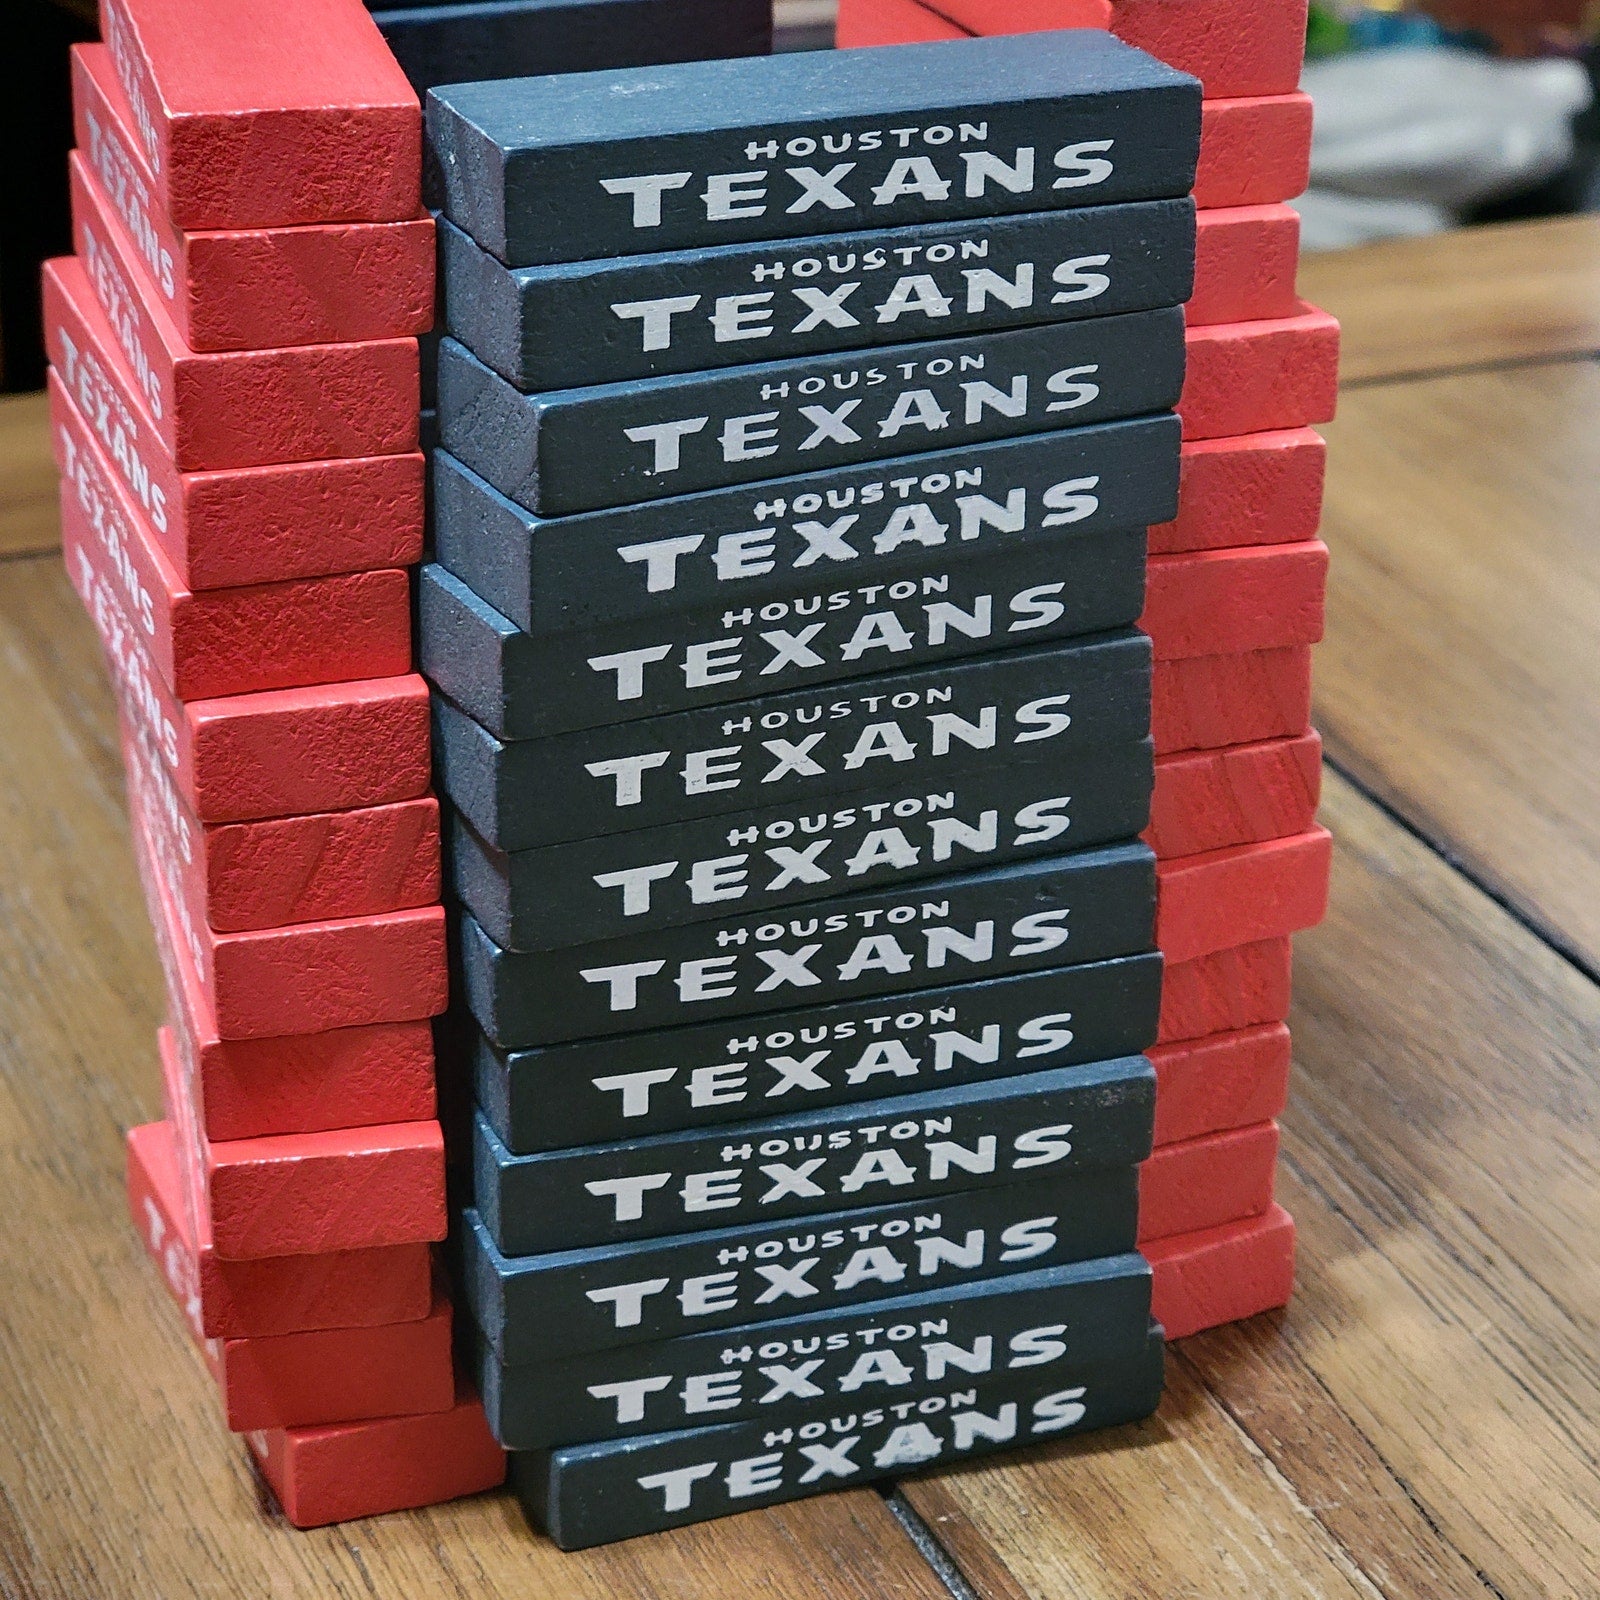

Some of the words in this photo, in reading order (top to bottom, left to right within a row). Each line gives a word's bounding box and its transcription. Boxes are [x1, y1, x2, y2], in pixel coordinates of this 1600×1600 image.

[598, 139, 1115, 228] TEXANS
[743, 121, 988, 161] HOUSTON
[86, 108, 175, 299] TEXANS
[610, 253, 1111, 352] TEXANS
[750, 239, 989, 283] HOUSTON
[83, 222, 163, 420] TEXANS
[622, 364, 1100, 473] TEXANS
[759, 353, 985, 401] HOUSTON
[58, 325, 167, 533] TEXANS
[60, 421, 154, 635] TEXANS
[616, 475, 1100, 593] TEXANS
[753, 466, 982, 522] HOUSTON
[586, 581, 1066, 701] TEXANS
[721, 574, 949, 629] HOUSTON
[76, 543, 179, 768] TEXANS
[584, 694, 1071, 807] TEXANS
[721, 685, 952, 736] HOUSTON
[592, 796, 1071, 916] TEXANS
[726, 791, 955, 847] HOUSTON
[579, 908, 1070, 1011] TEXANS
[715, 900, 949, 947] HOUSTON
[591, 1012, 1073, 1118] TEXANS
[726, 1007, 956, 1055] HOUSTON
[584, 1124, 1073, 1222] TEXANS
[720, 1116, 952, 1162] HOUSTON
[585, 1216, 1058, 1328] TEXANS
[716, 1213, 942, 1265] HOUSTON
[586, 1324, 1068, 1424] TEXANS
[719, 1318, 948, 1365] HOUSTON
[637, 1387, 1087, 1512] TEXANS
[763, 1389, 977, 1447] HOUSTON
